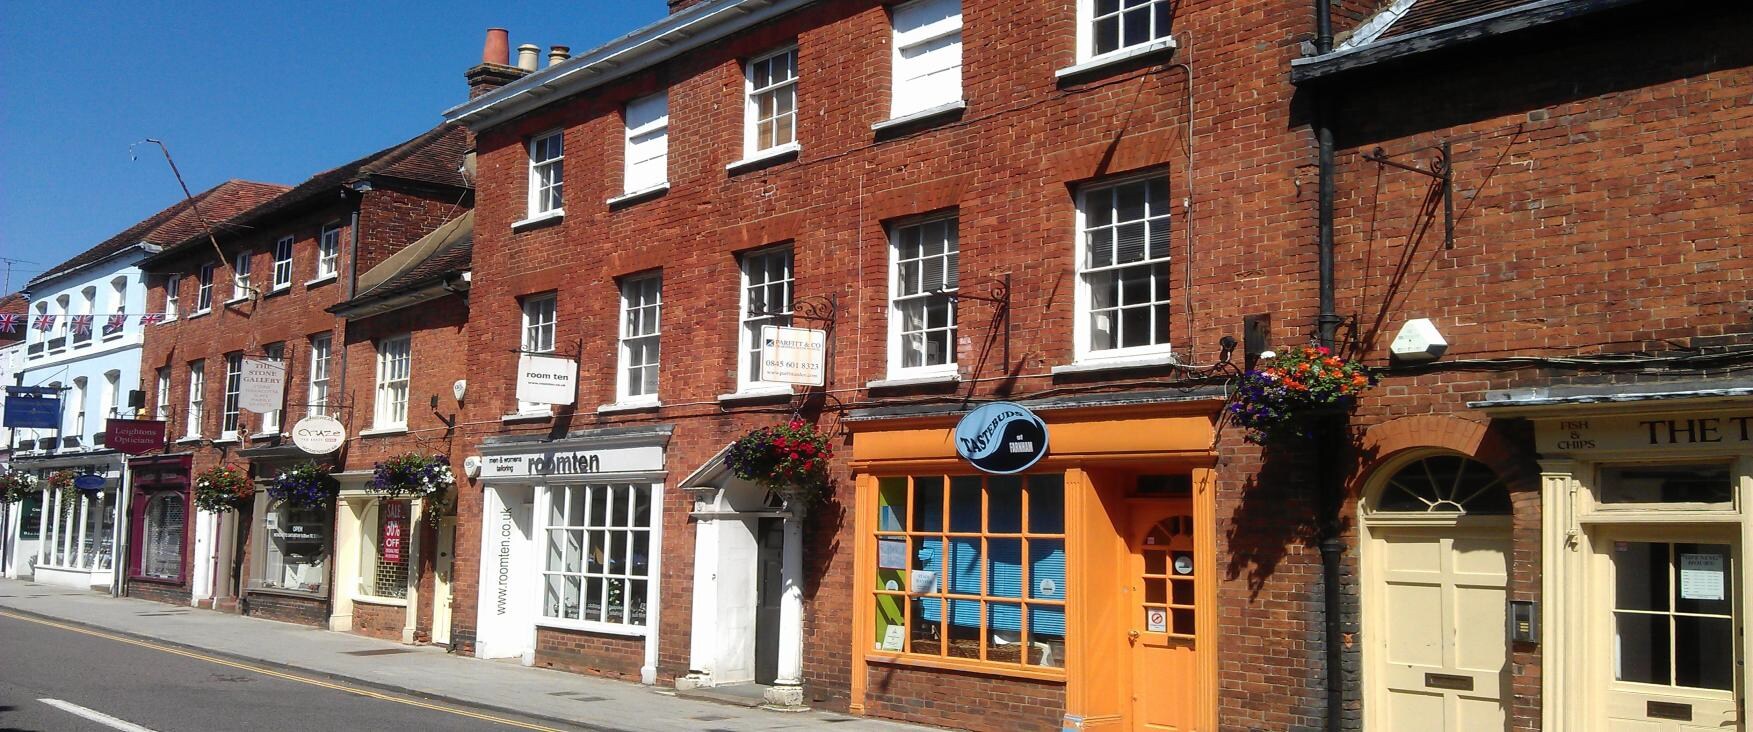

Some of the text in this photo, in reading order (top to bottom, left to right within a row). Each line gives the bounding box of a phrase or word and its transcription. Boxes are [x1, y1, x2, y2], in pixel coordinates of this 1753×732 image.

[765, 360, 819, 370] 0845 601 8323
[1560, 420, 1590, 430] FISH
[115, 427, 157, 436] Leightons
[960, 410, 1024, 453] TASTEBUDS
[1570, 430, 1581, 440] &
[1639, 418, 1723, 445] THE
[114, 436, 155, 444] Opticians
[1557, 439, 1597, 450] CHIPS
[1009, 441, 1034, 453] FARNHAM
[527, 450, 600, 476] roomten
[496, 464, 513, 473] tailoring
[387, 503, 401, 518] SALE
[385, 538, 400, 548] OFF
[497, 507, 512, 616] www.roomten.co.uk
